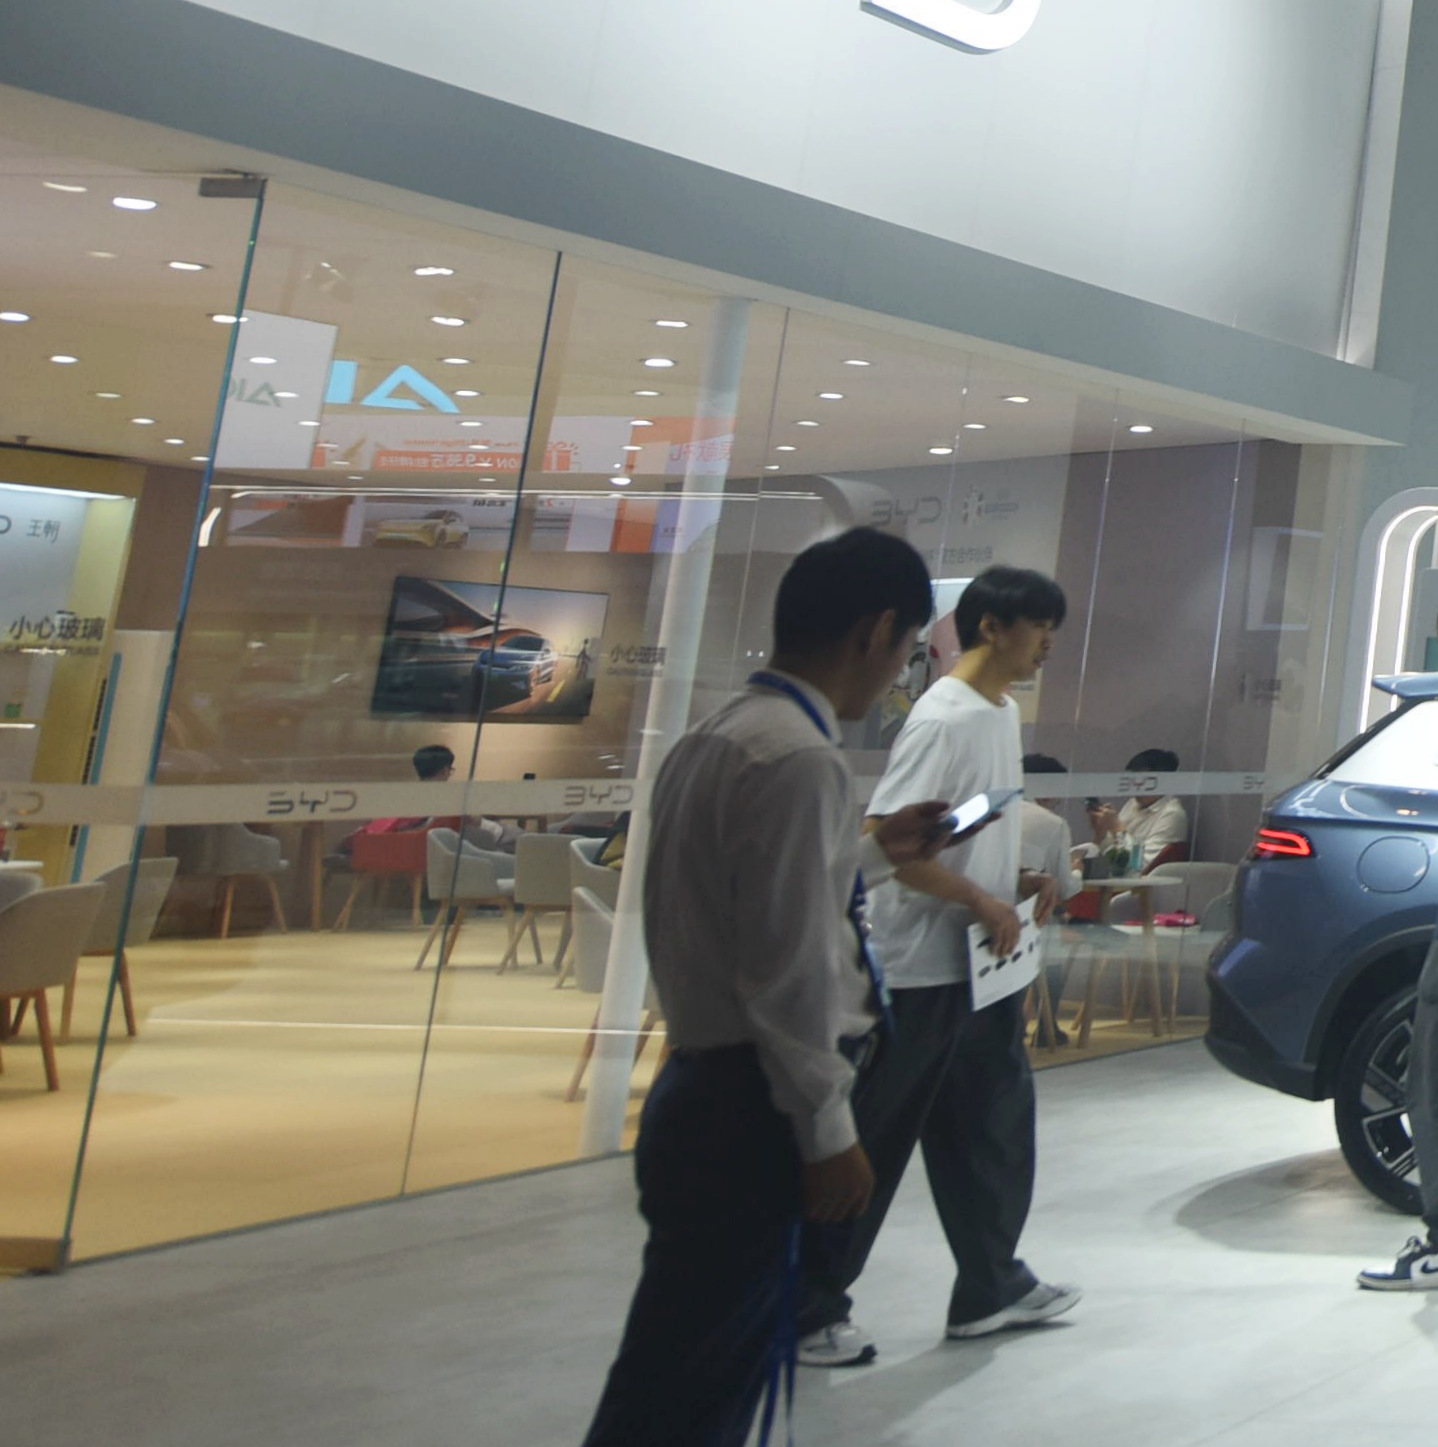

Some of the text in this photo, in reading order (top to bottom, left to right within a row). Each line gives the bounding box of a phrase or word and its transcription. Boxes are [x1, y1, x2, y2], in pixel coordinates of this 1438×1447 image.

[9, 615, 105, 642] 小心玻璃
[562, 784, 636, 807] BYD
[1118, 776, 1159, 792] BYD
[266, 790, 358, 815] BYD
